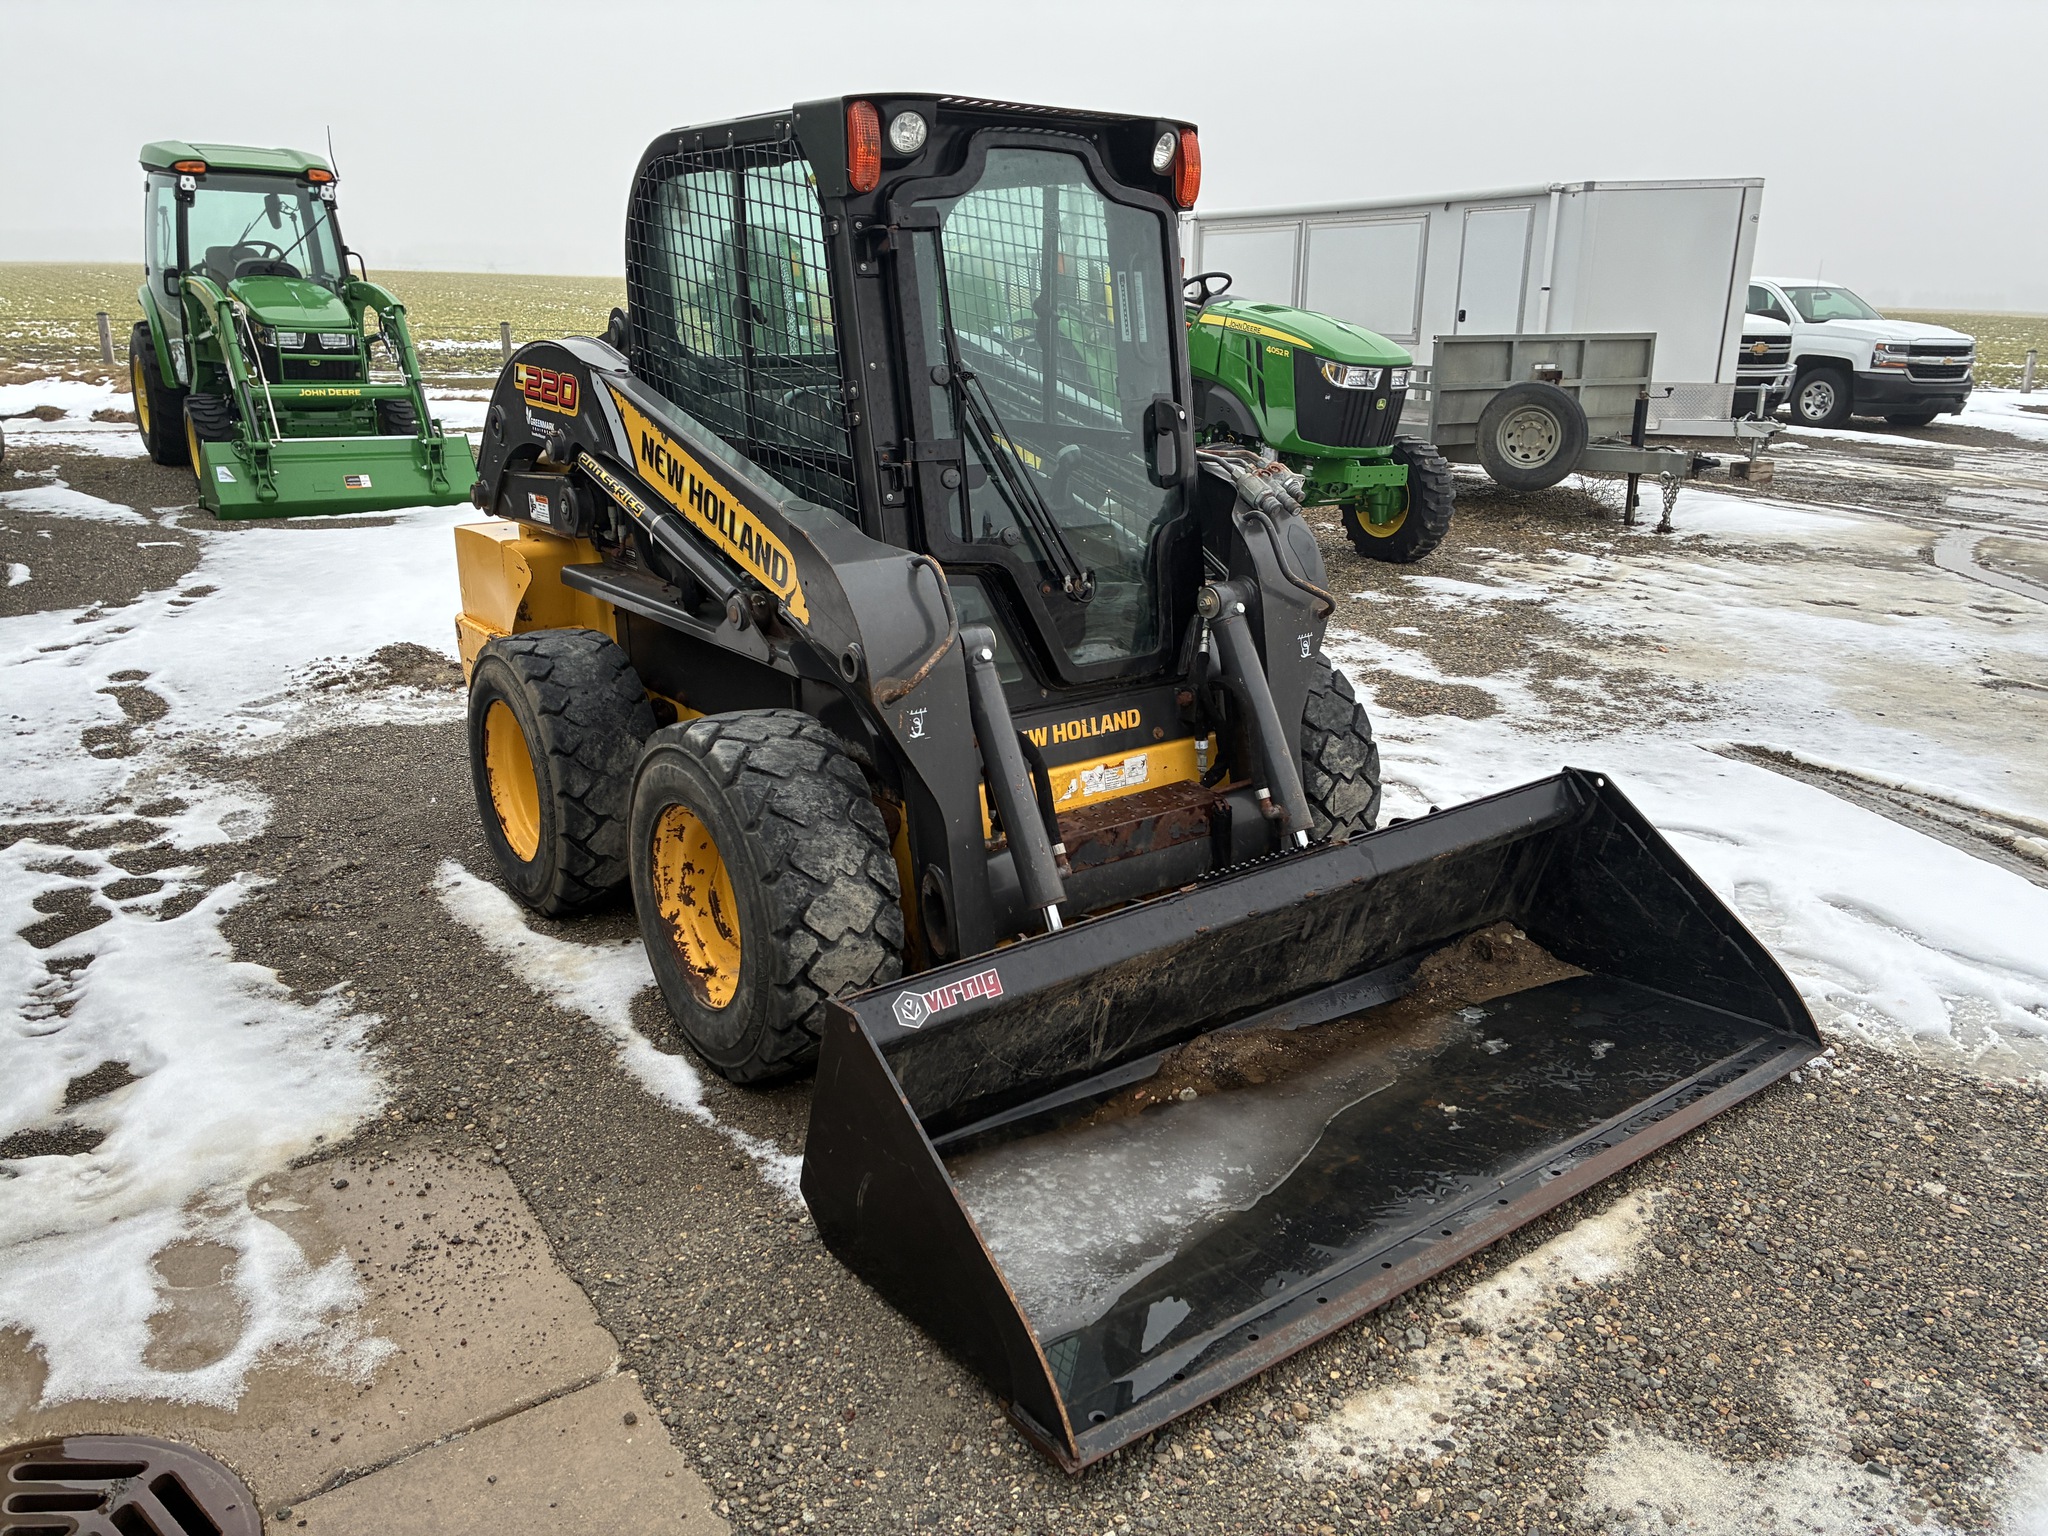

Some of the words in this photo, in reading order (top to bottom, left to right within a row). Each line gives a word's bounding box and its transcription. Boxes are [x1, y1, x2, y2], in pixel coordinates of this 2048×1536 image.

[1228, 320, 1242, 330] JOHN
[1242, 322, 1262, 334] DEERE
[299, 388, 326, 396] JOHN
[327, 388, 362, 396] DEERE
[514, 365, 578, 411] L220
[530, 417, 555, 431] GREENMARK
[603, 475, 645, 514] SERIES
[641, 430, 685, 495] NEW
[688, 472, 788, 589] HOLLAND
[1052, 708, 1141, 744] HOLLAND
